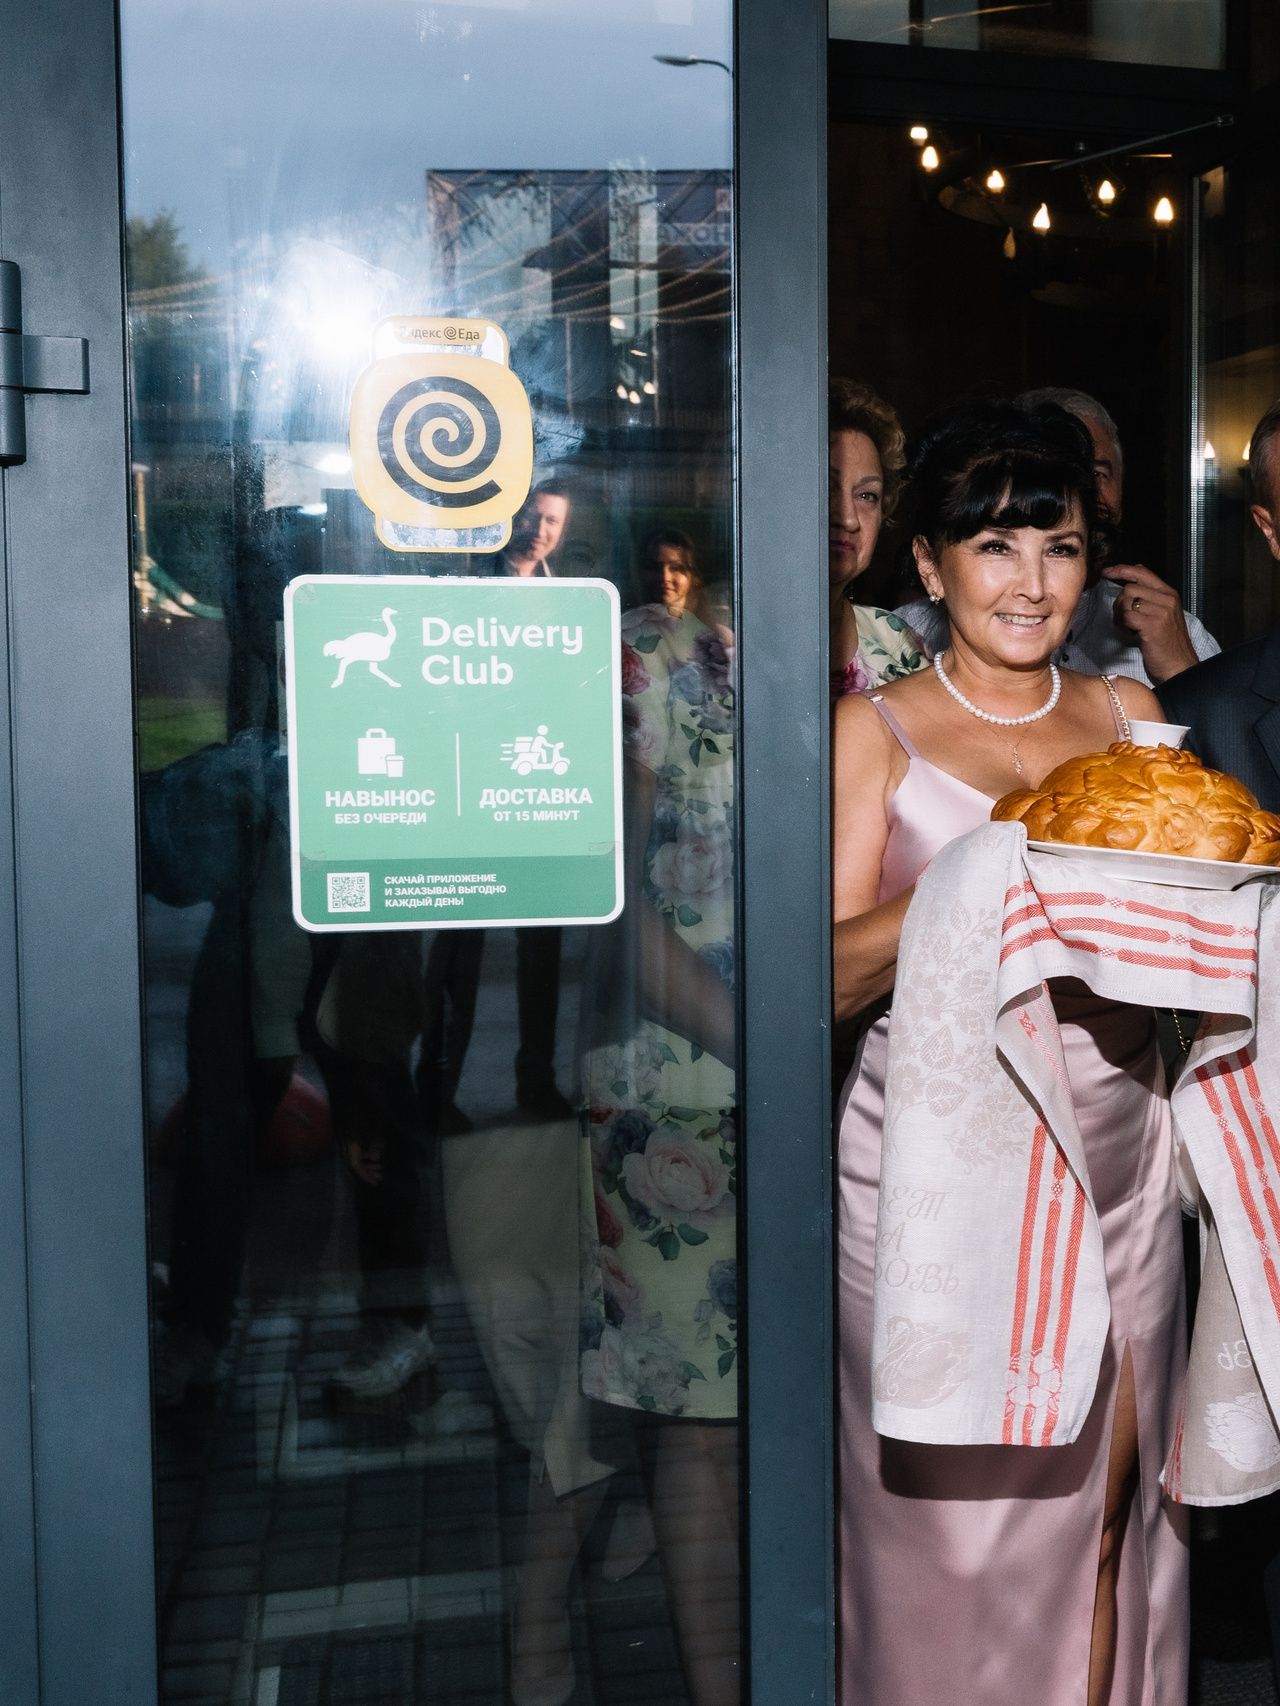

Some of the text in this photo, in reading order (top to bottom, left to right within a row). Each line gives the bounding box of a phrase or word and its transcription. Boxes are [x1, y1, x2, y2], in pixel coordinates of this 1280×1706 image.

[458, 328, 481, 341] Еда
[422, 617, 583, 655] Delivery
[421, 655, 514, 685] Club
[325, 789, 436, 807] НАВЫНОС
[479, 788, 593, 808] ДОСТАВКА
[335, 812, 427, 825] БЕЗ ОЧЕРЕДИ
[494, 810, 580, 822] ОТ 15 МИНУТ
[384, 873, 497, 885] СКАЧАЙ ПРИЛОЖЕНИЕ
[385, 885, 507, 896] И ЗАКАЗЫВАЙ ВЫГОДНО
[385, 897, 464, 908] КАЖДЫЙ ДЕНЬ!
